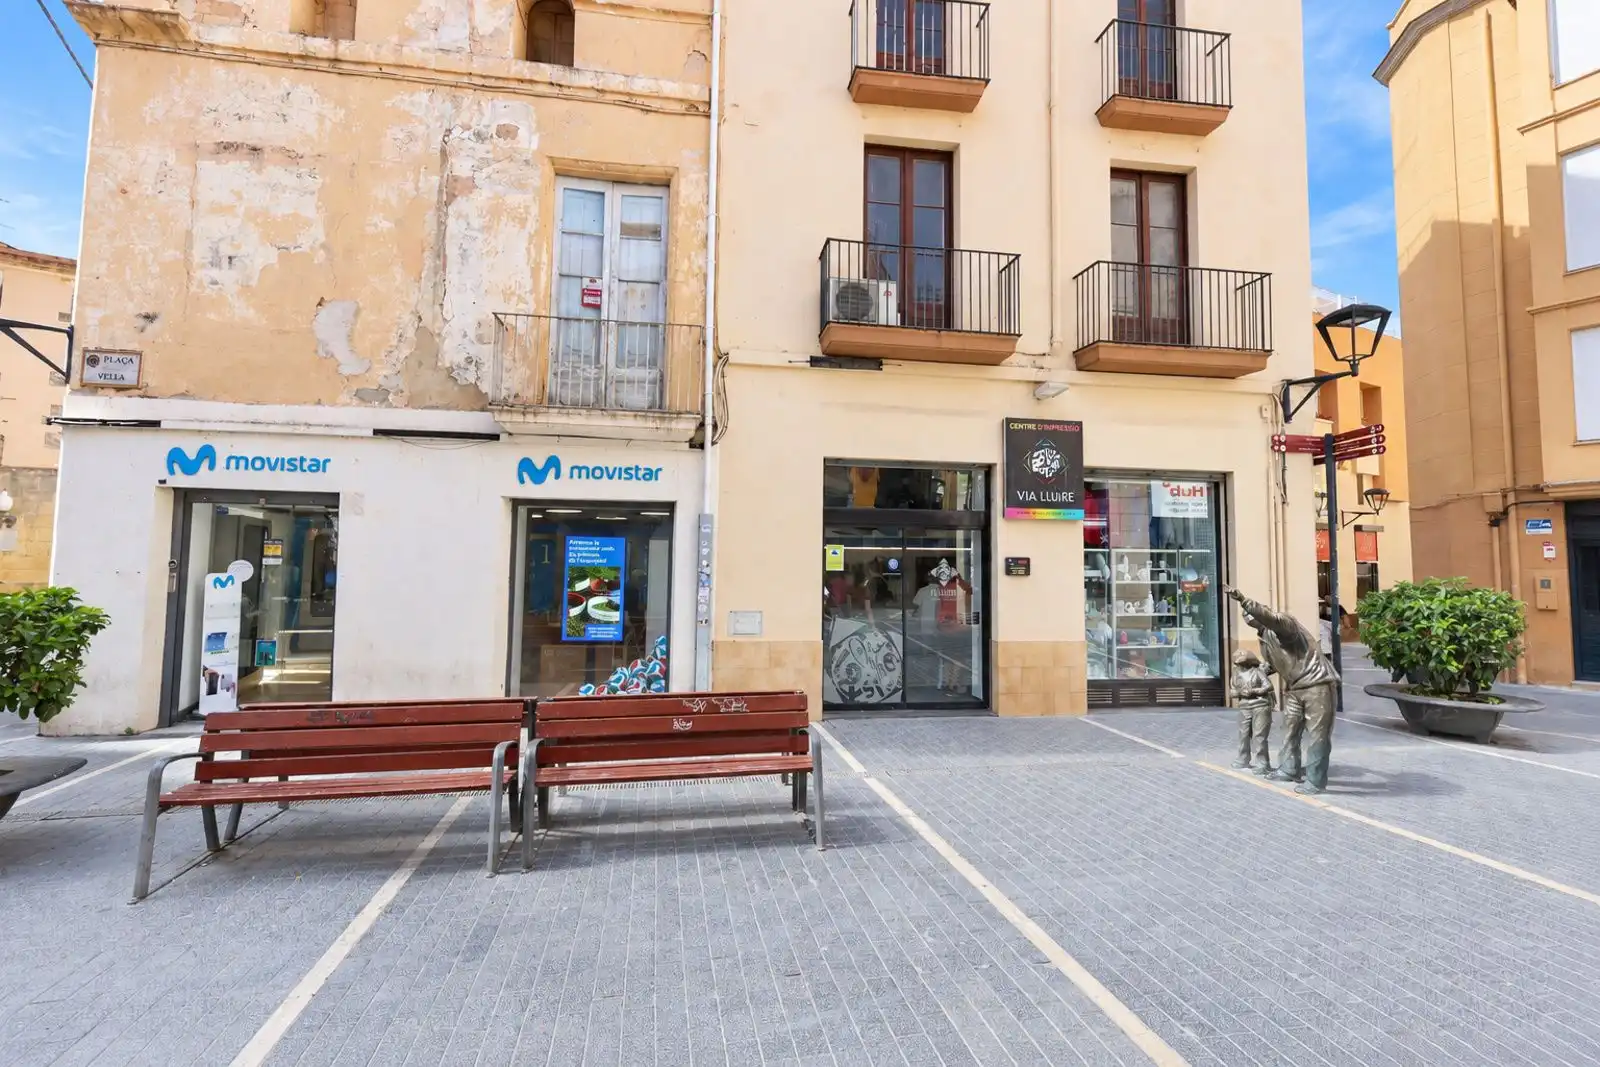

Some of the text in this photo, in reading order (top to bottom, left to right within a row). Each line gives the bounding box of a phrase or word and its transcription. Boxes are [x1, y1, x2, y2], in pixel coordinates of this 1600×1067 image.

[97, 372, 125, 380] VELLA
[1009, 422, 1037, 431] CENTRE
[225, 454, 331, 473] movistar
[568, 464, 663, 481] movistar
[1016, 490, 1038, 502] VIA
